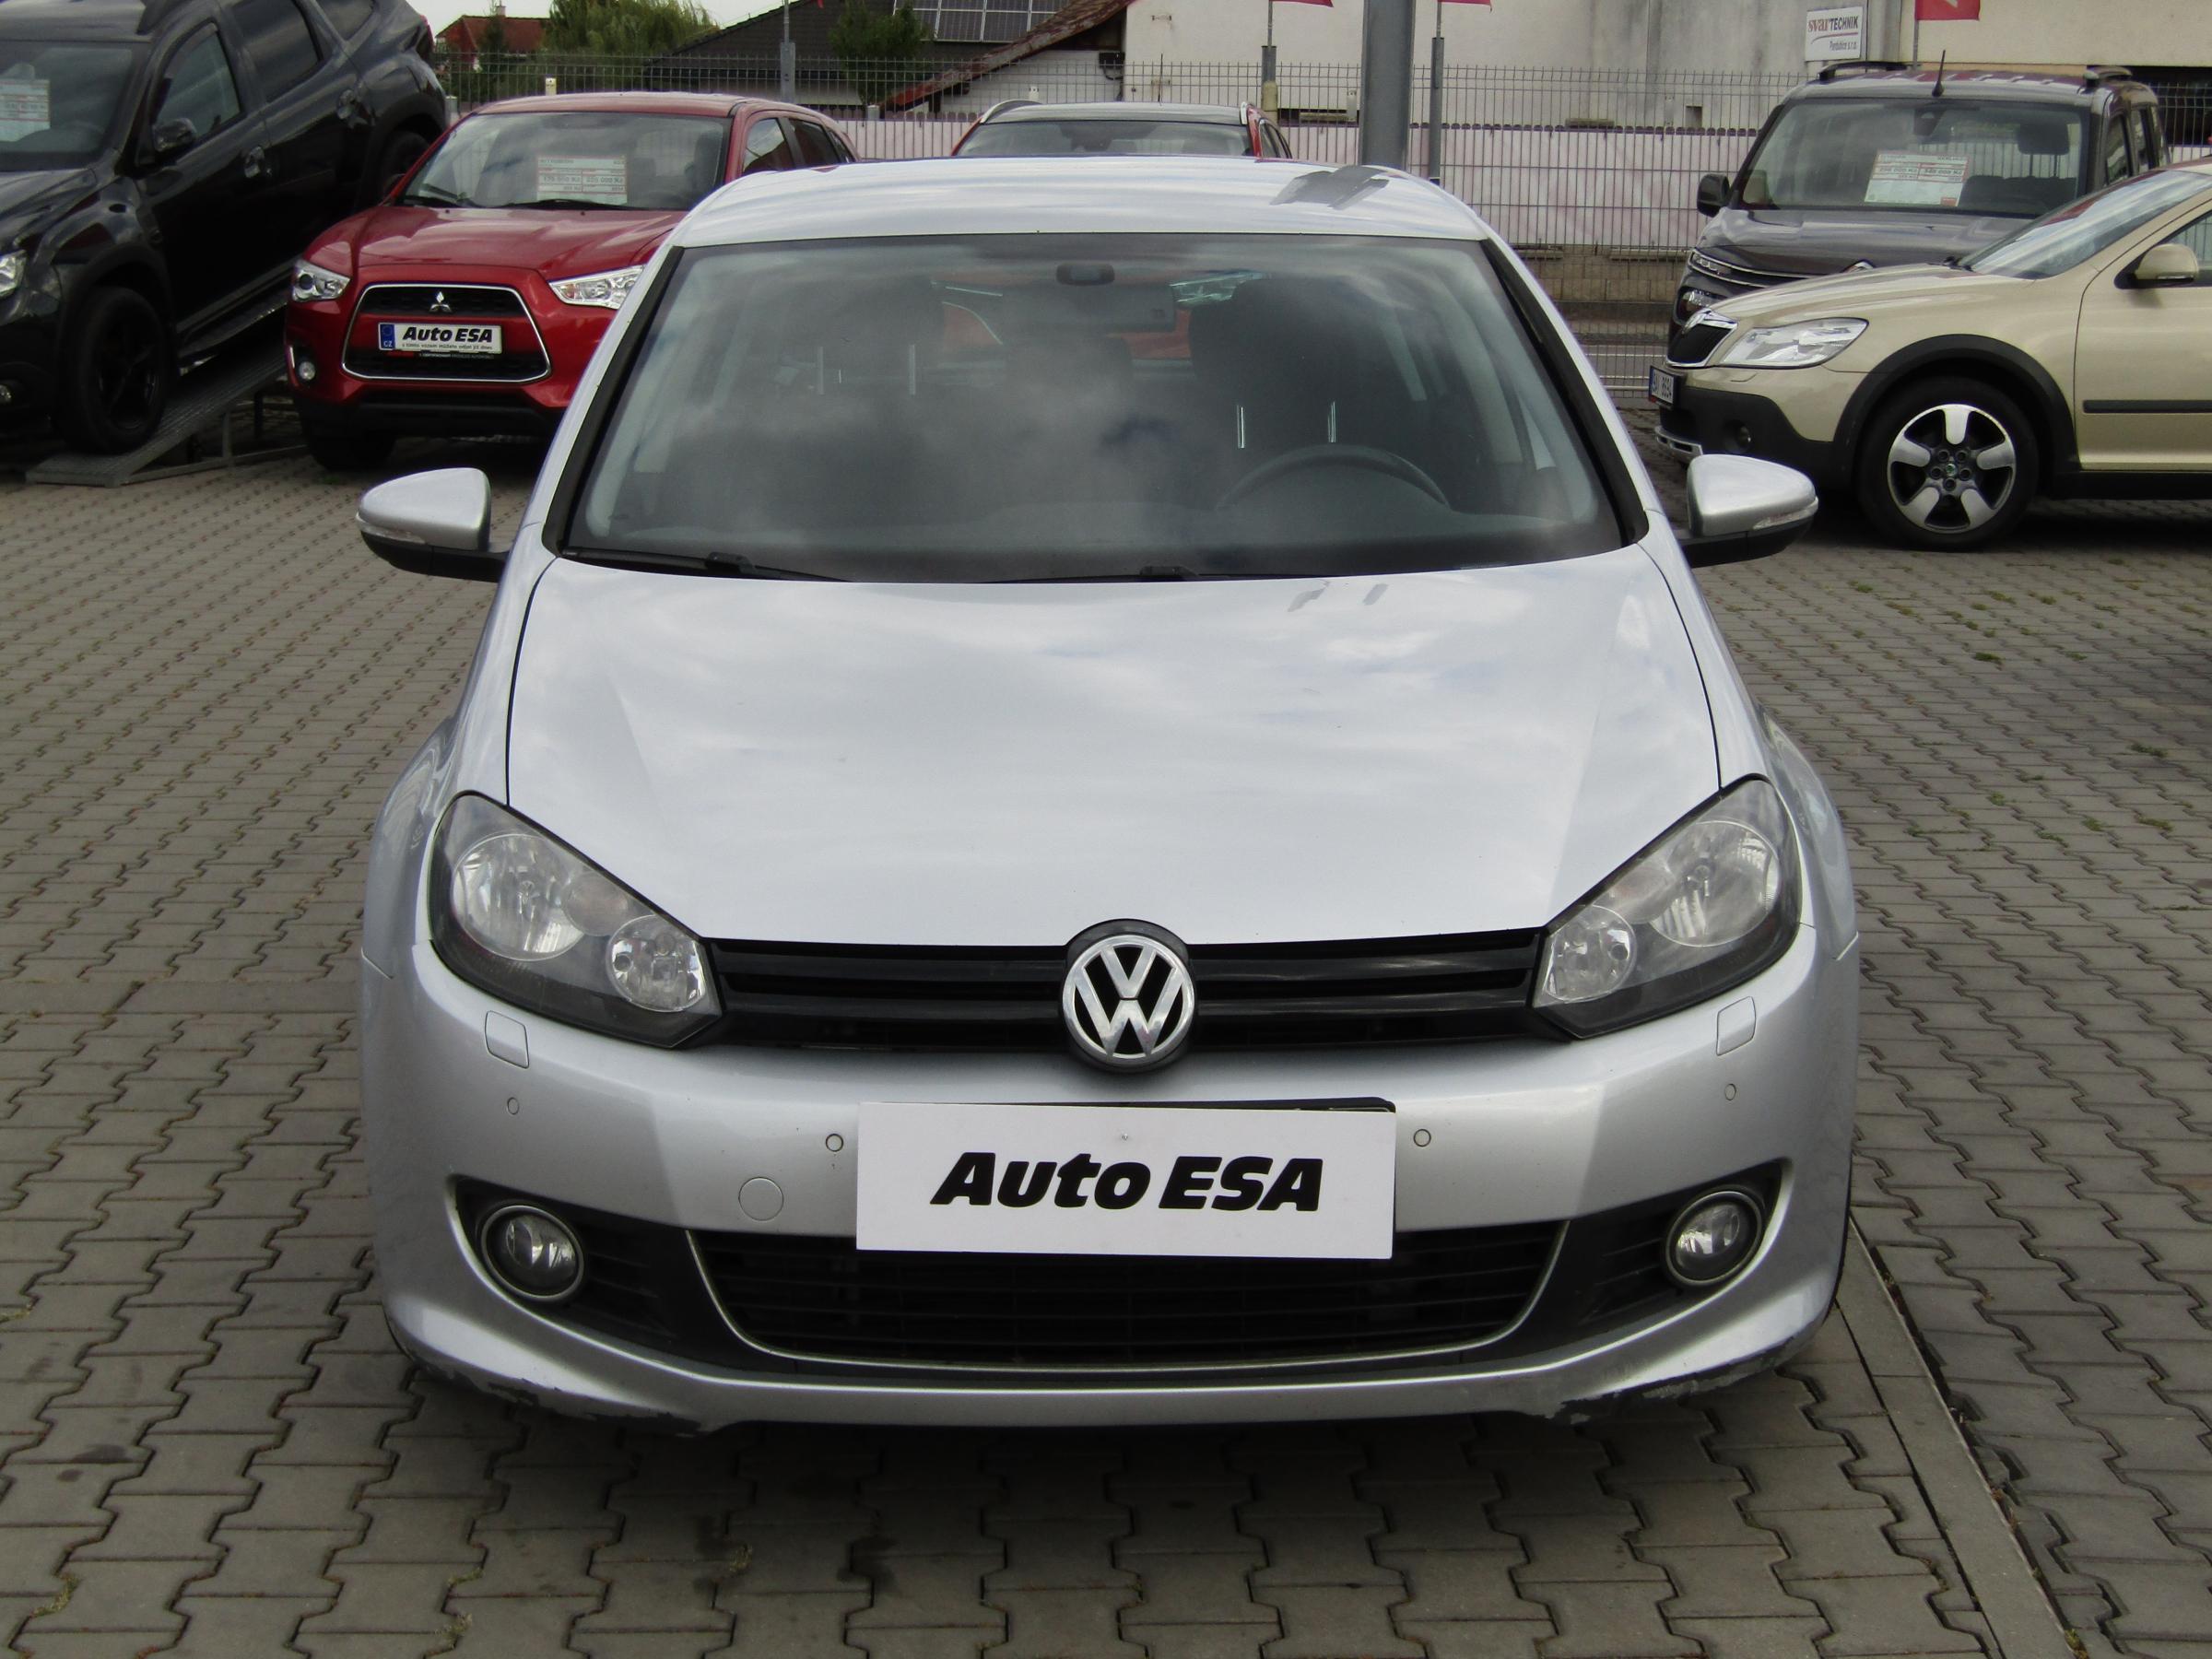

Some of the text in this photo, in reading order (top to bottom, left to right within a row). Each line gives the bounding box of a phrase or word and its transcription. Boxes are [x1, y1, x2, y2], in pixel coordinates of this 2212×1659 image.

[402, 326, 493, 343] Auto ESA
[929, 1152, 1324, 1211] Auto ESA
